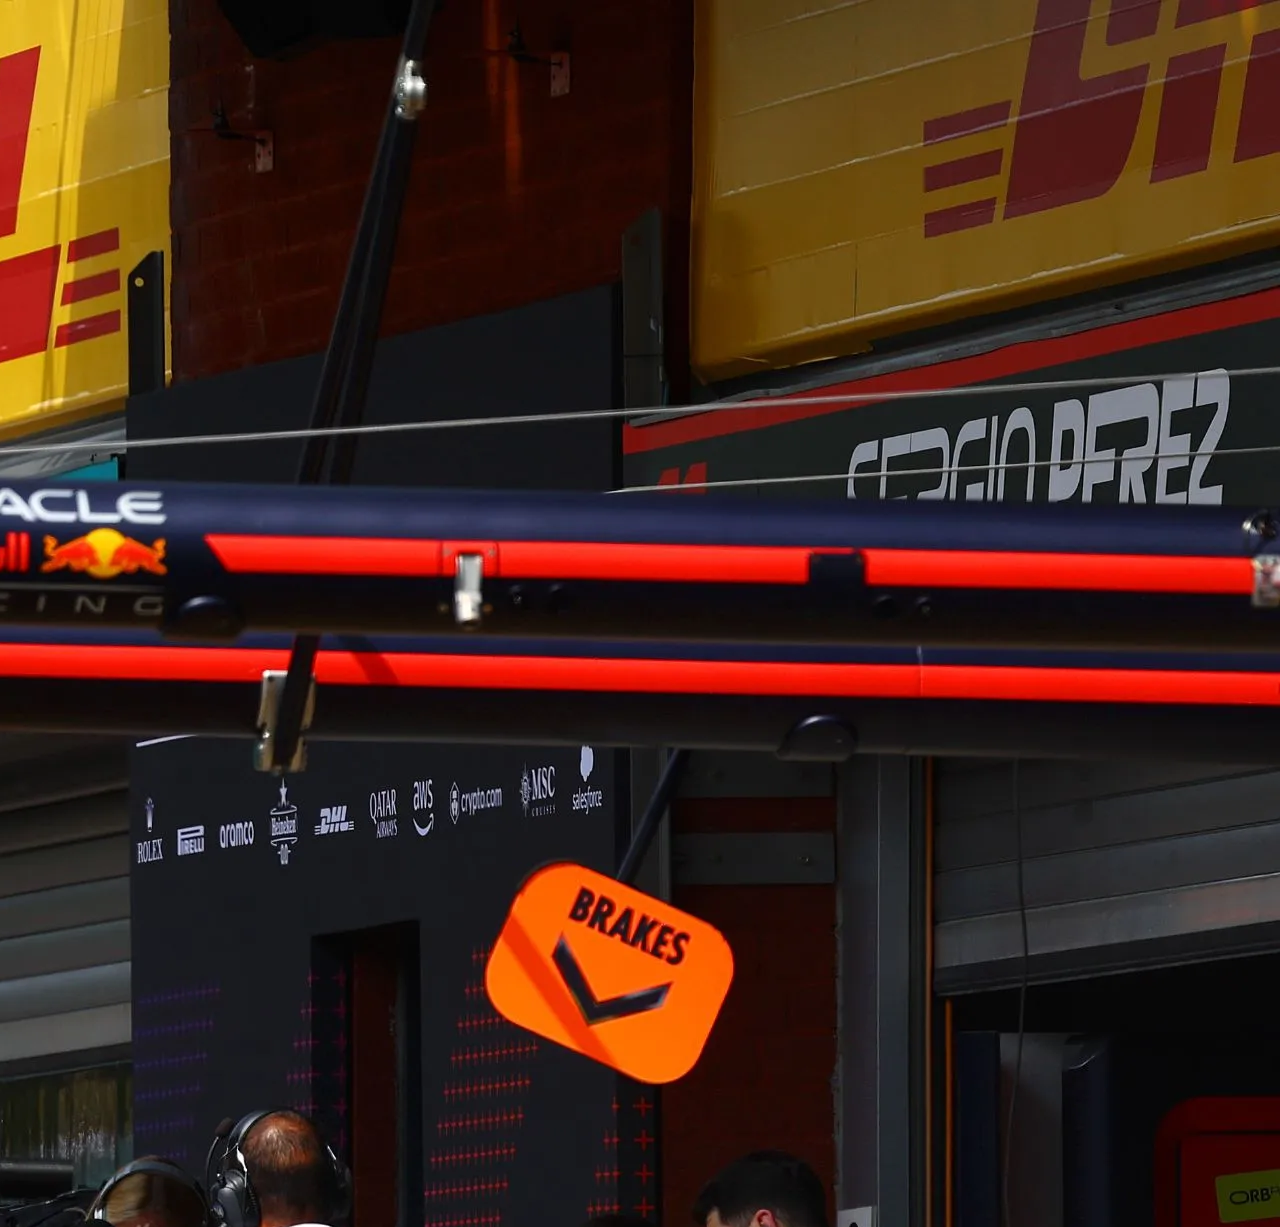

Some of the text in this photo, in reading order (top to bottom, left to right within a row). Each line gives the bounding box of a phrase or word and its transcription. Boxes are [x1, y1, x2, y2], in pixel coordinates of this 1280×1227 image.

[1048, 368, 1229, 504] PEREZ
[413, 779, 433, 810] aws
[532, 765, 555, 801] MSC
[369, 788, 397, 824] QATAR
[461, 786, 502, 815] crypto.com
[572, 785, 603, 815] salesforce
[220, 820, 254, 849] aramco
[319, 804, 351, 835] DHL
[137, 837, 163, 864] ROLEX
[177, 824, 204, 857] PIRELLI
[569, 886, 691, 967] BRAKES
